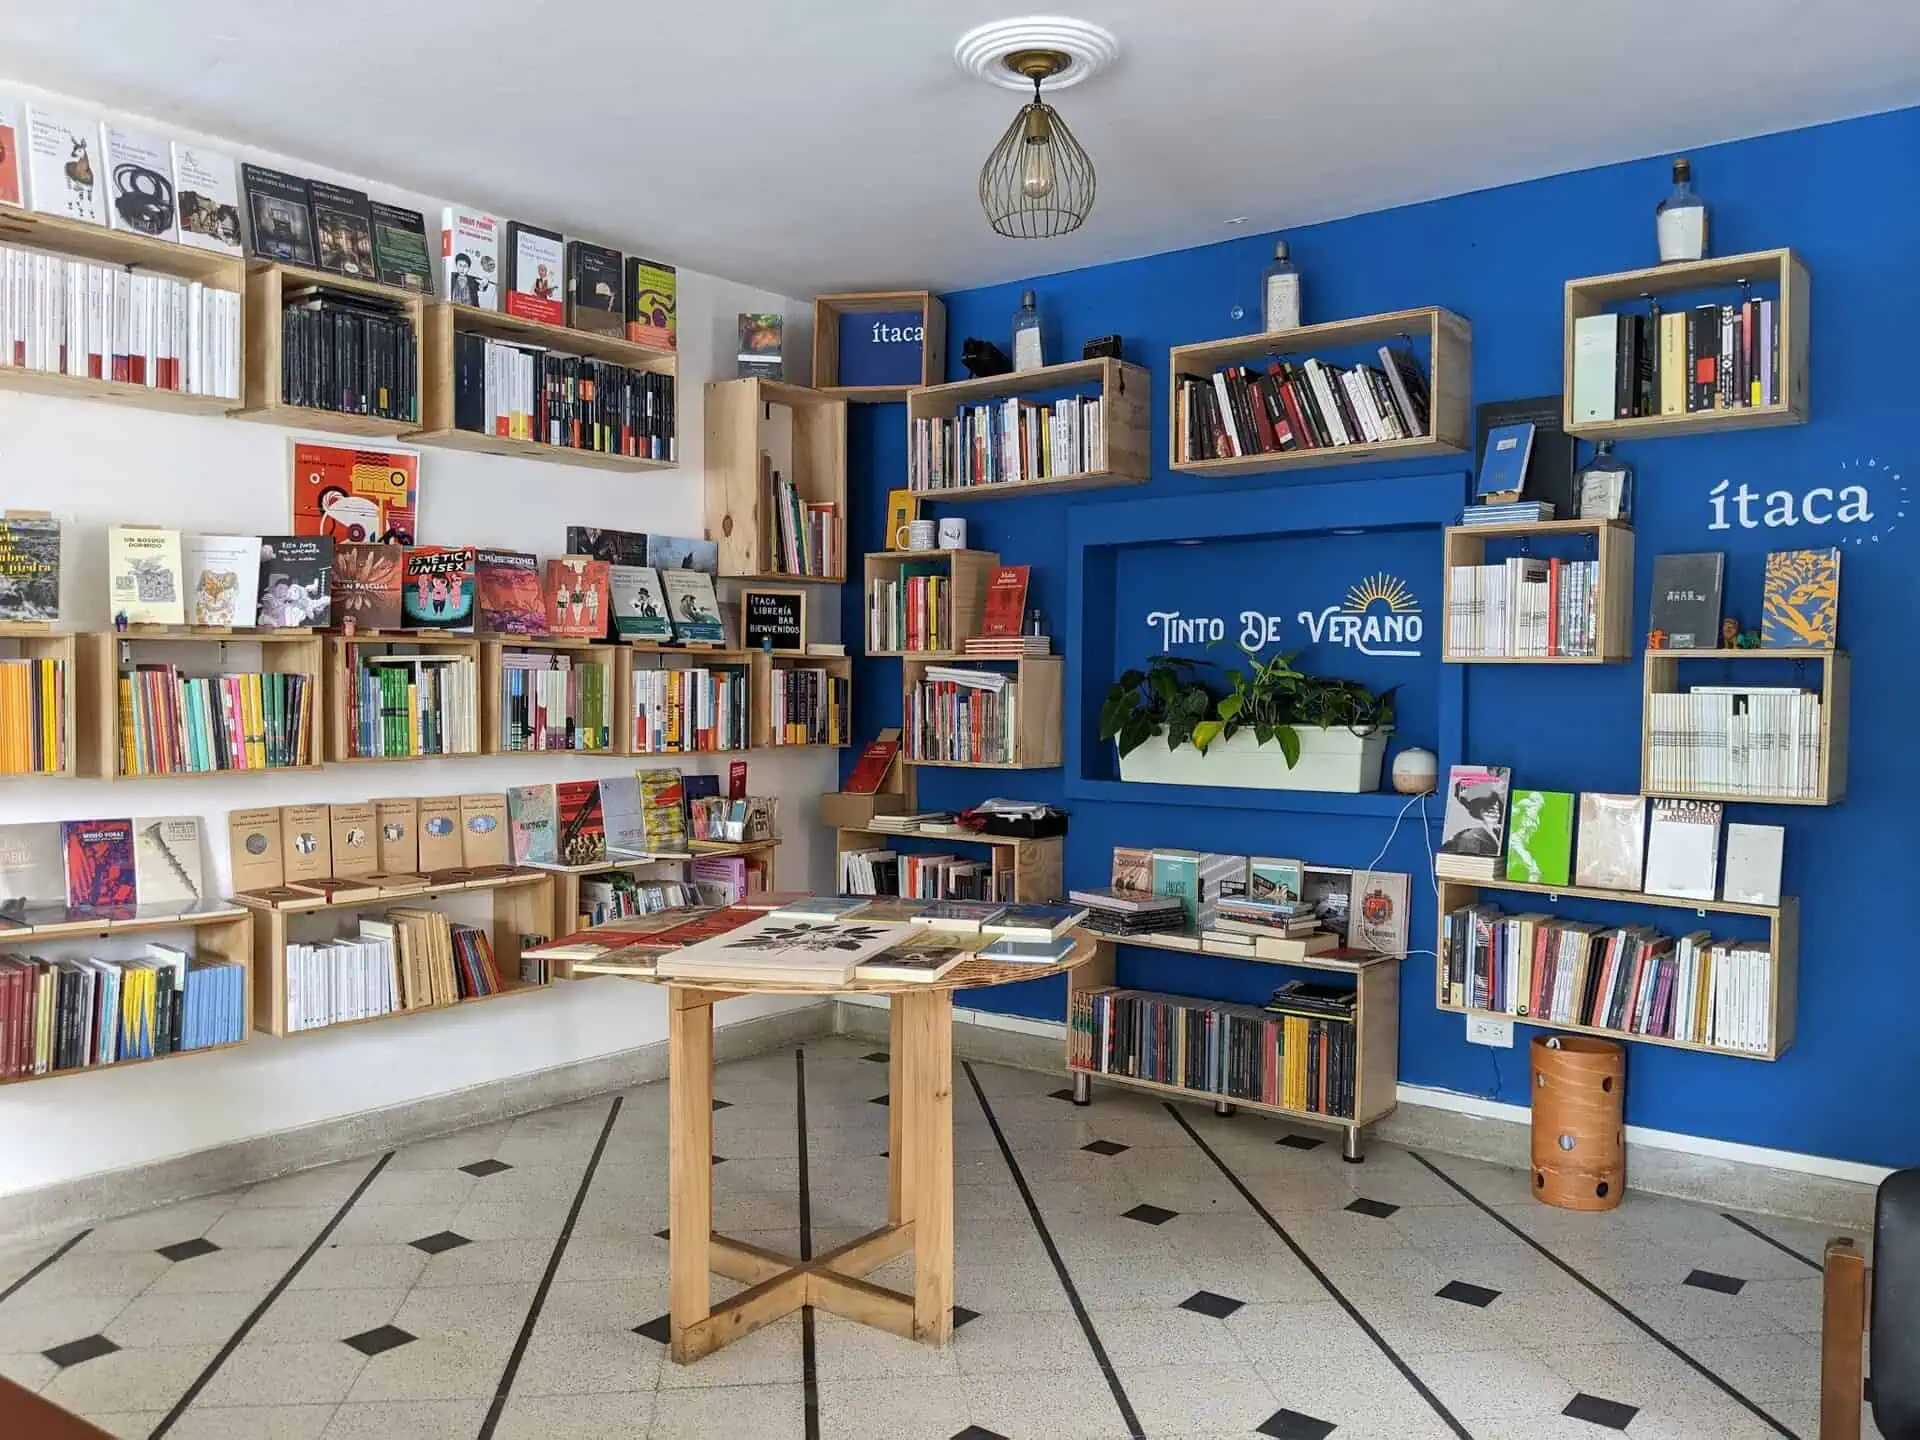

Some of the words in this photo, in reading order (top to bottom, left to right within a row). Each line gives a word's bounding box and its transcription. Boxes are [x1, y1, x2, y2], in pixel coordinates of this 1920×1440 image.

[872, 321, 924, 342] ítaca
[1707, 479, 1875, 530] ítaca
[409, 562, 464, 575] UNISEX
[750, 594, 776, 606] ÍTACA
[753, 604, 793, 616] LIBRERÍA
[778, 616, 794, 625] BAR
[750, 624, 801, 634] BIENVENIDOS
[1146, 611, 1225, 652] TINTO
[1239, 611, 1282, 652] DE
[1297, 606, 1424, 656] VERANO
[1653, 798, 1722, 813] VILLORO
